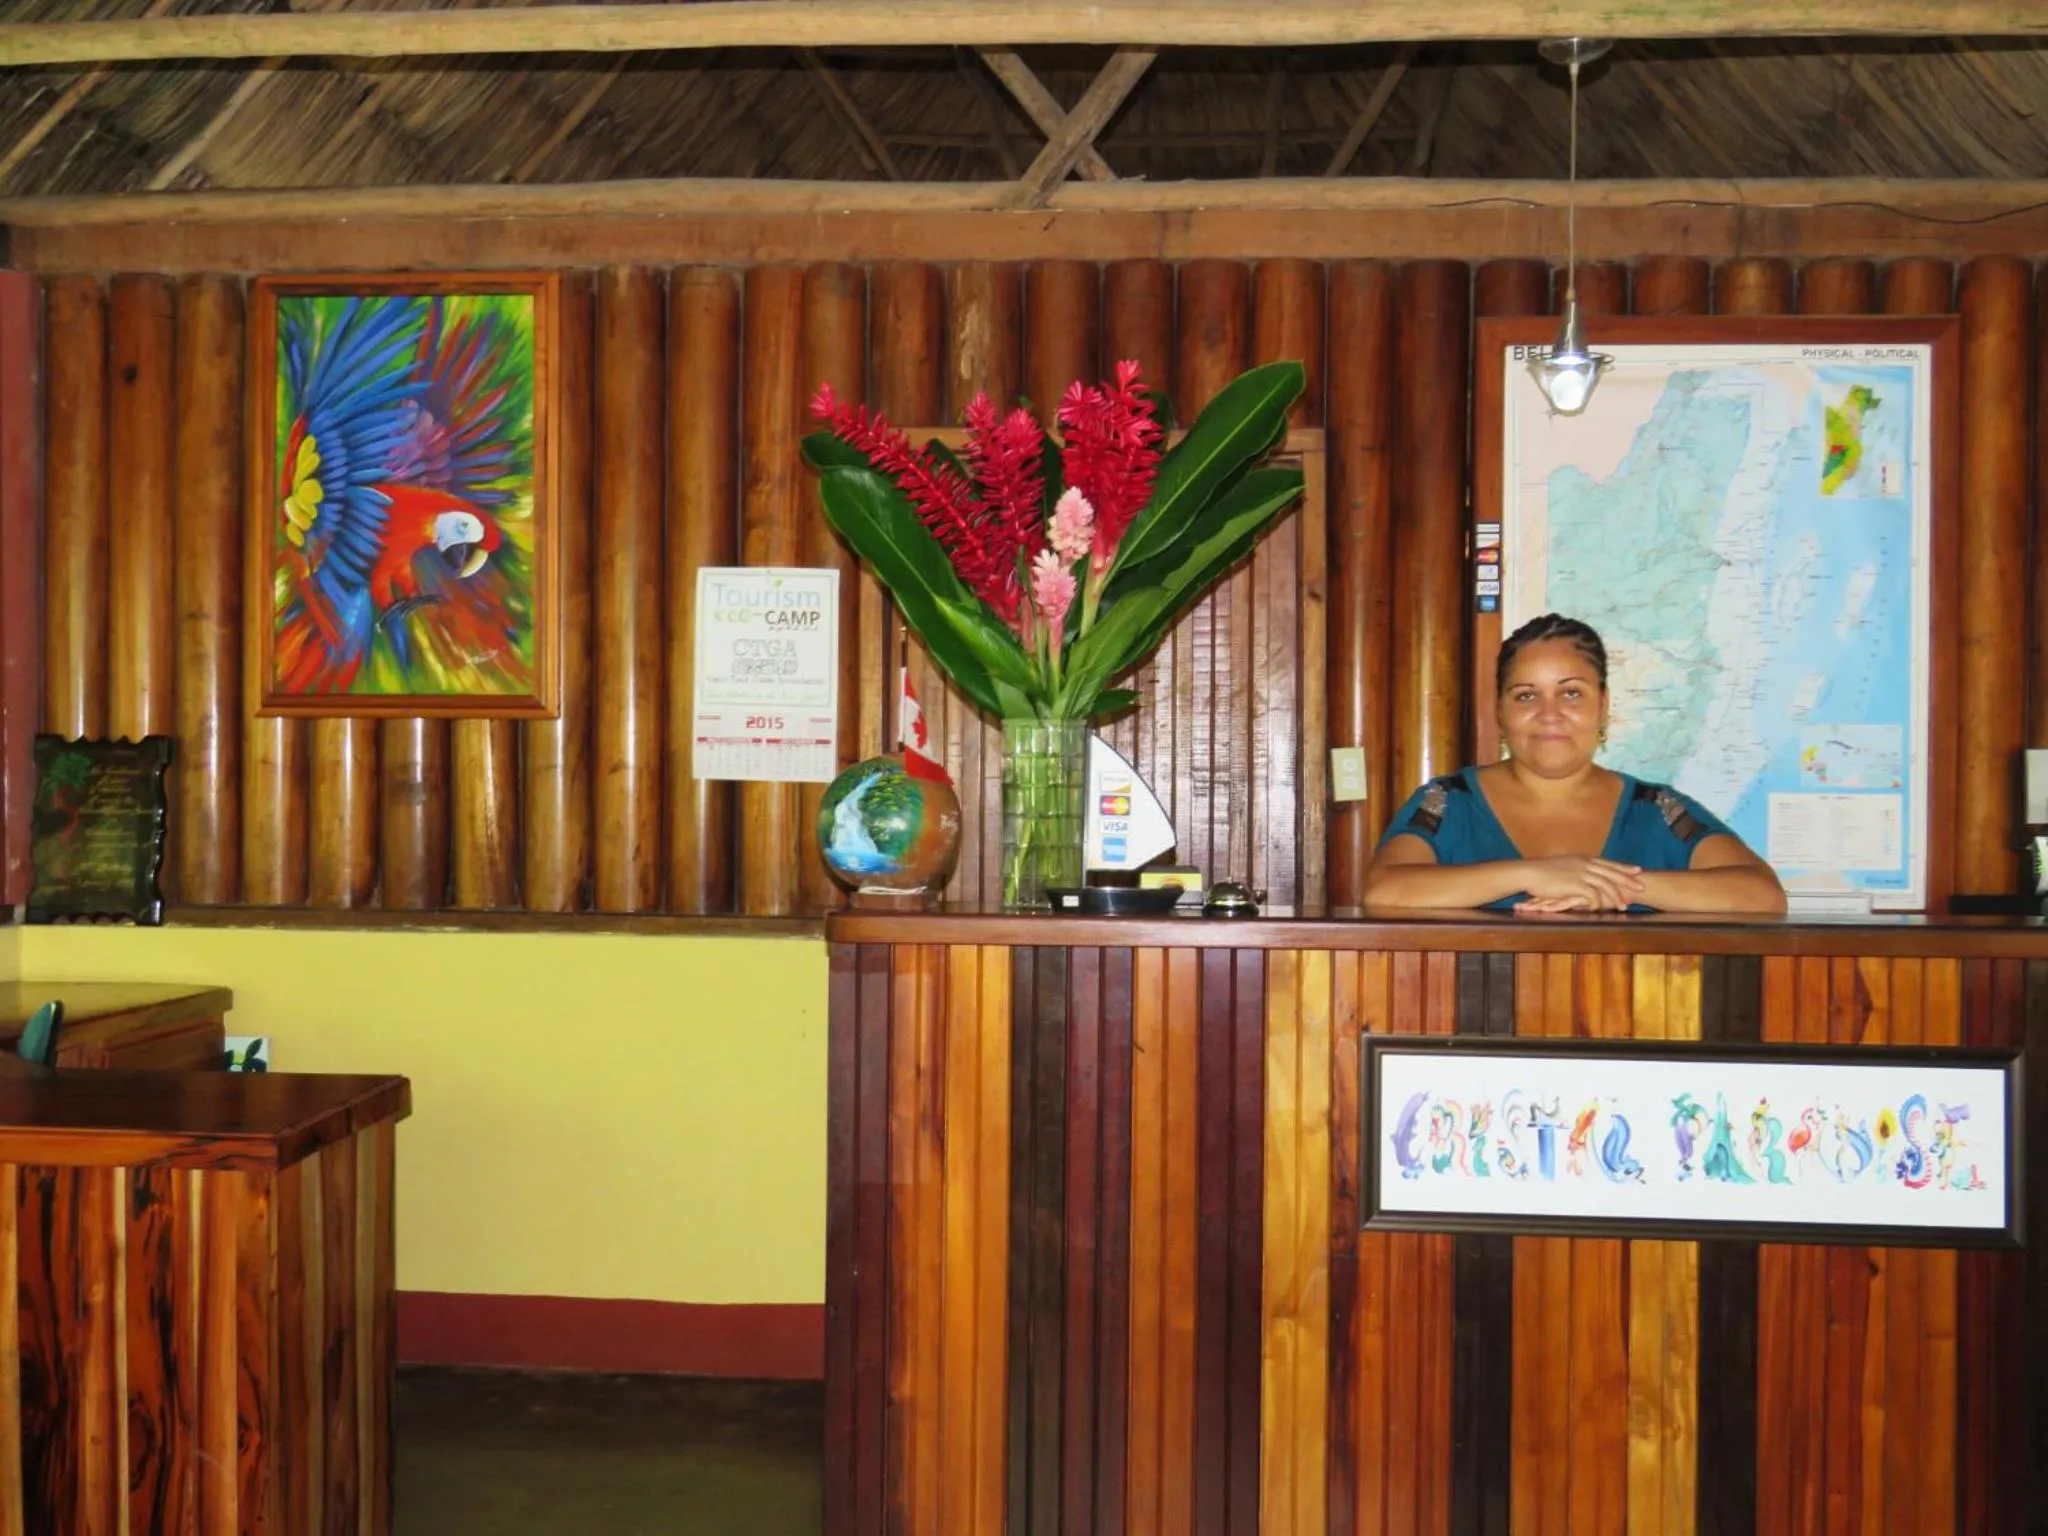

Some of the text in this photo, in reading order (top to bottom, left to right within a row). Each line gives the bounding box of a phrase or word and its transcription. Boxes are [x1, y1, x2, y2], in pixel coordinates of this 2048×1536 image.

[711, 579, 821, 608] Tourism
[746, 716, 784, 729] 2015
[1103, 821, 1128, 831] VISA
